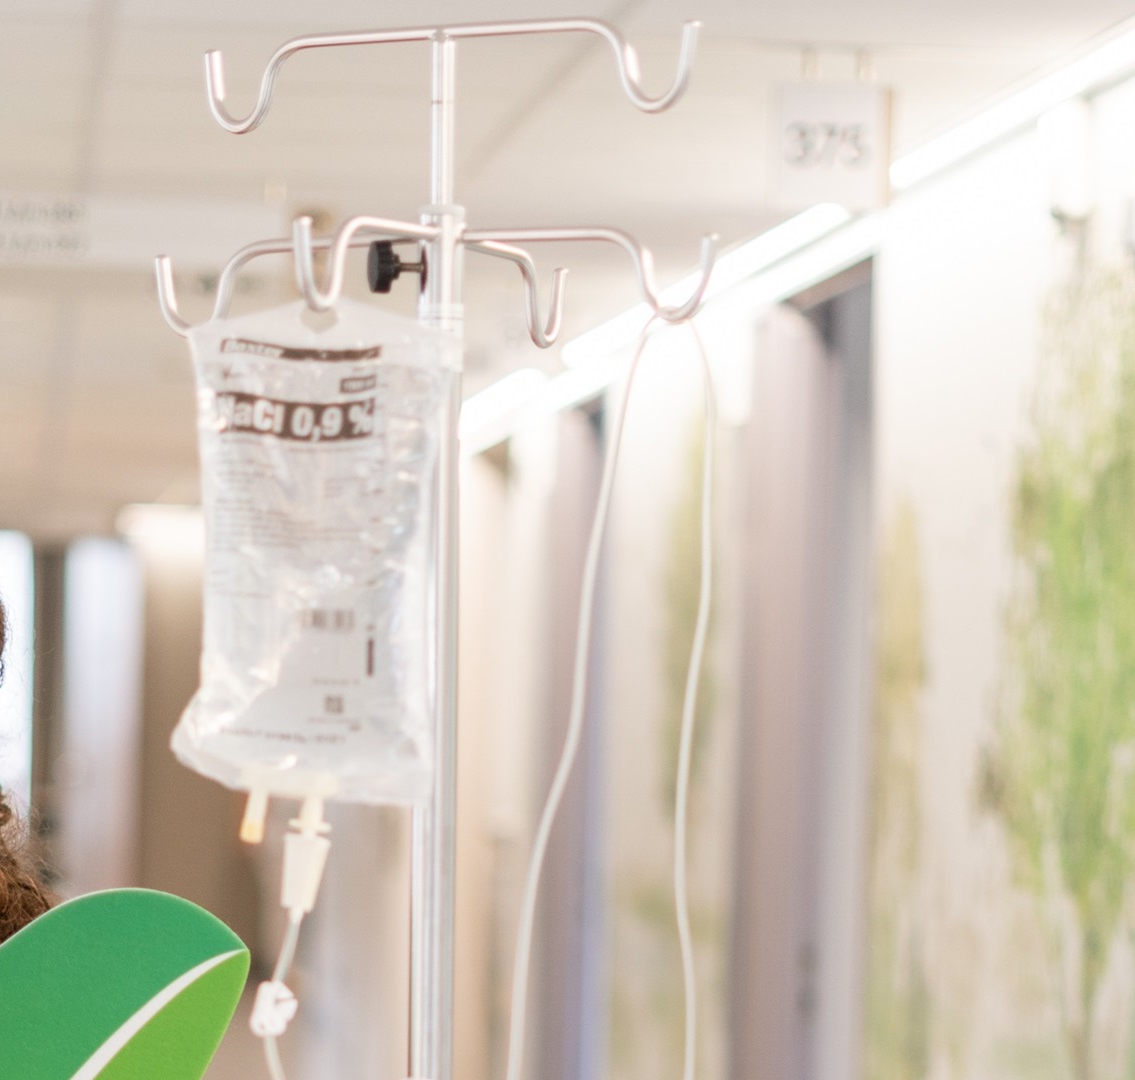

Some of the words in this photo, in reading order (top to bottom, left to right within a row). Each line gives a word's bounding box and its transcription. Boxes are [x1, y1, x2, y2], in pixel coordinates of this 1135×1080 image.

[784, 121, 872, 170] 375
[290, 404, 343, 442] 0,9
[348, 402, 375, 436] %
